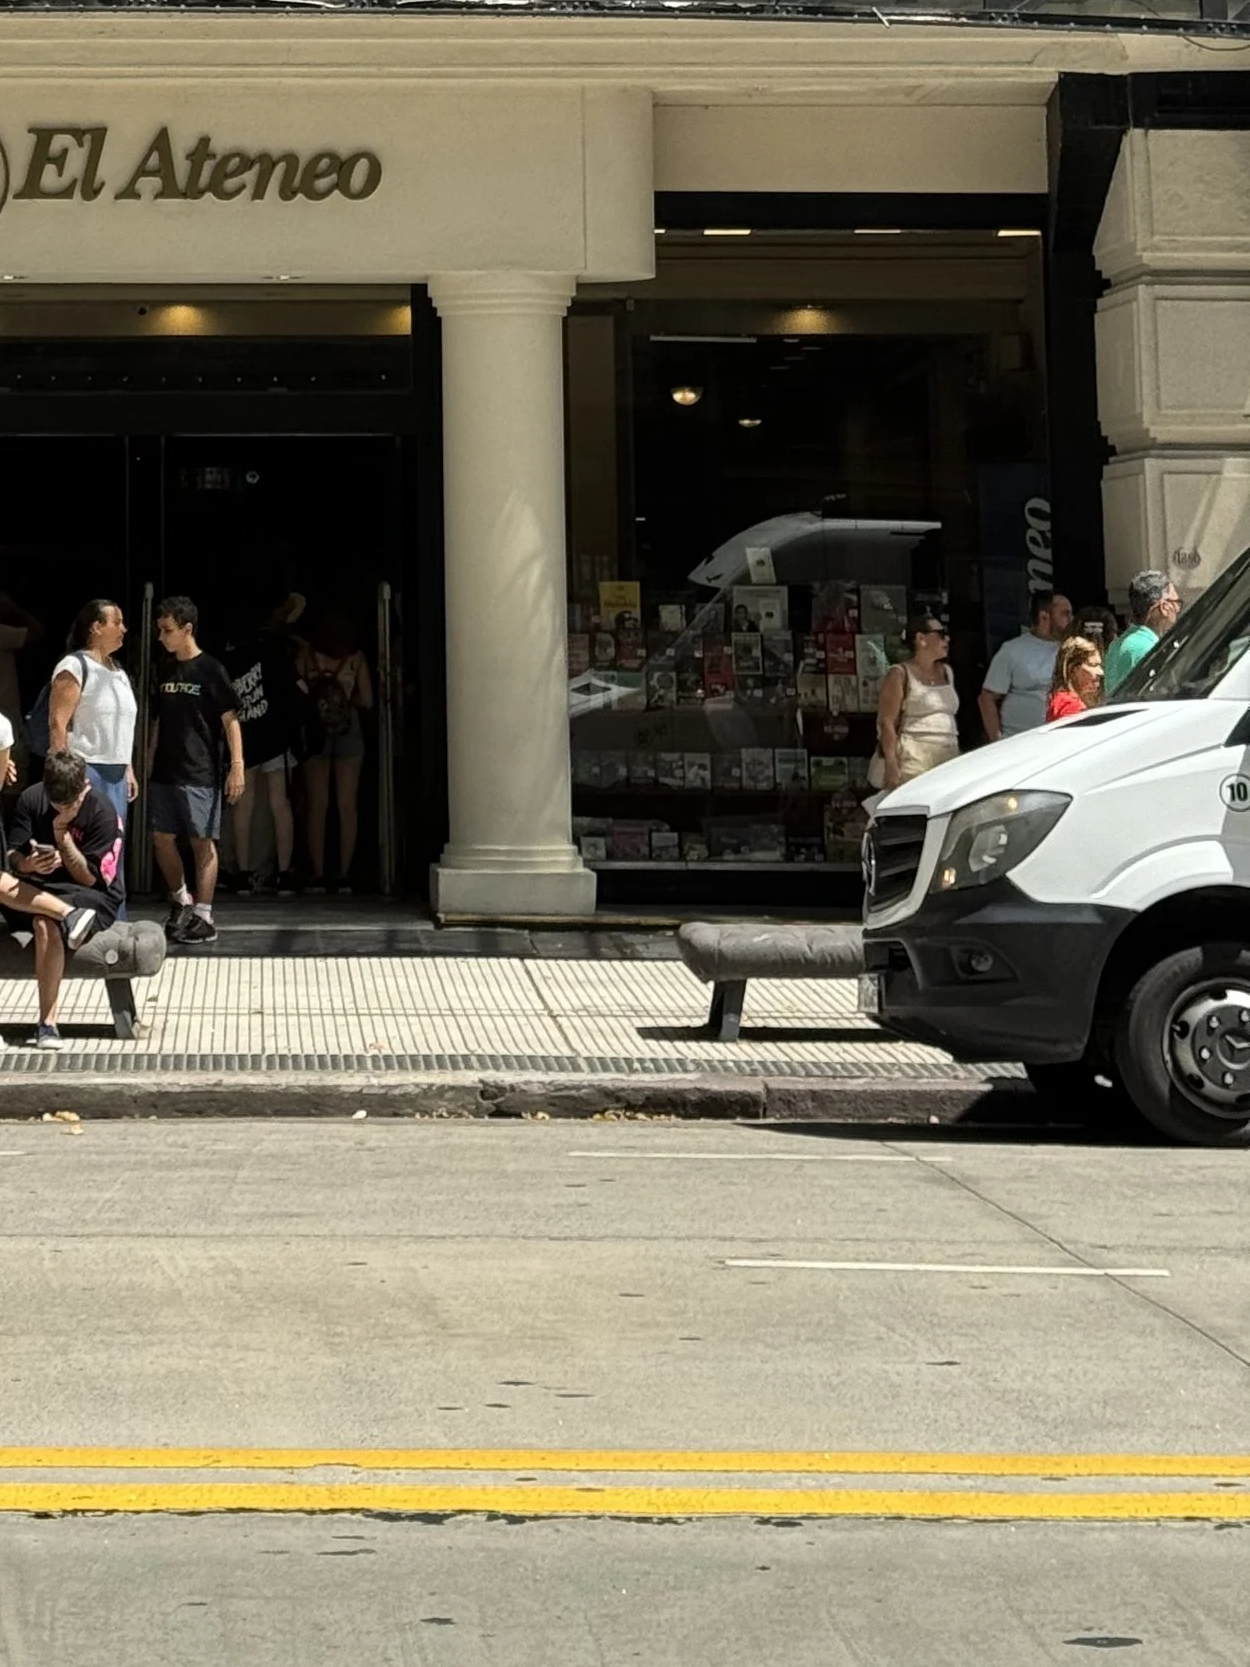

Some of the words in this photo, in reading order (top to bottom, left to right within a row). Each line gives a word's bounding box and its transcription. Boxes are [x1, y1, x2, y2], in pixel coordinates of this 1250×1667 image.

[13, 126, 108, 202] El
[114, 125, 382, 202] Ateneo
[1024, 497, 1053, 593] neo
